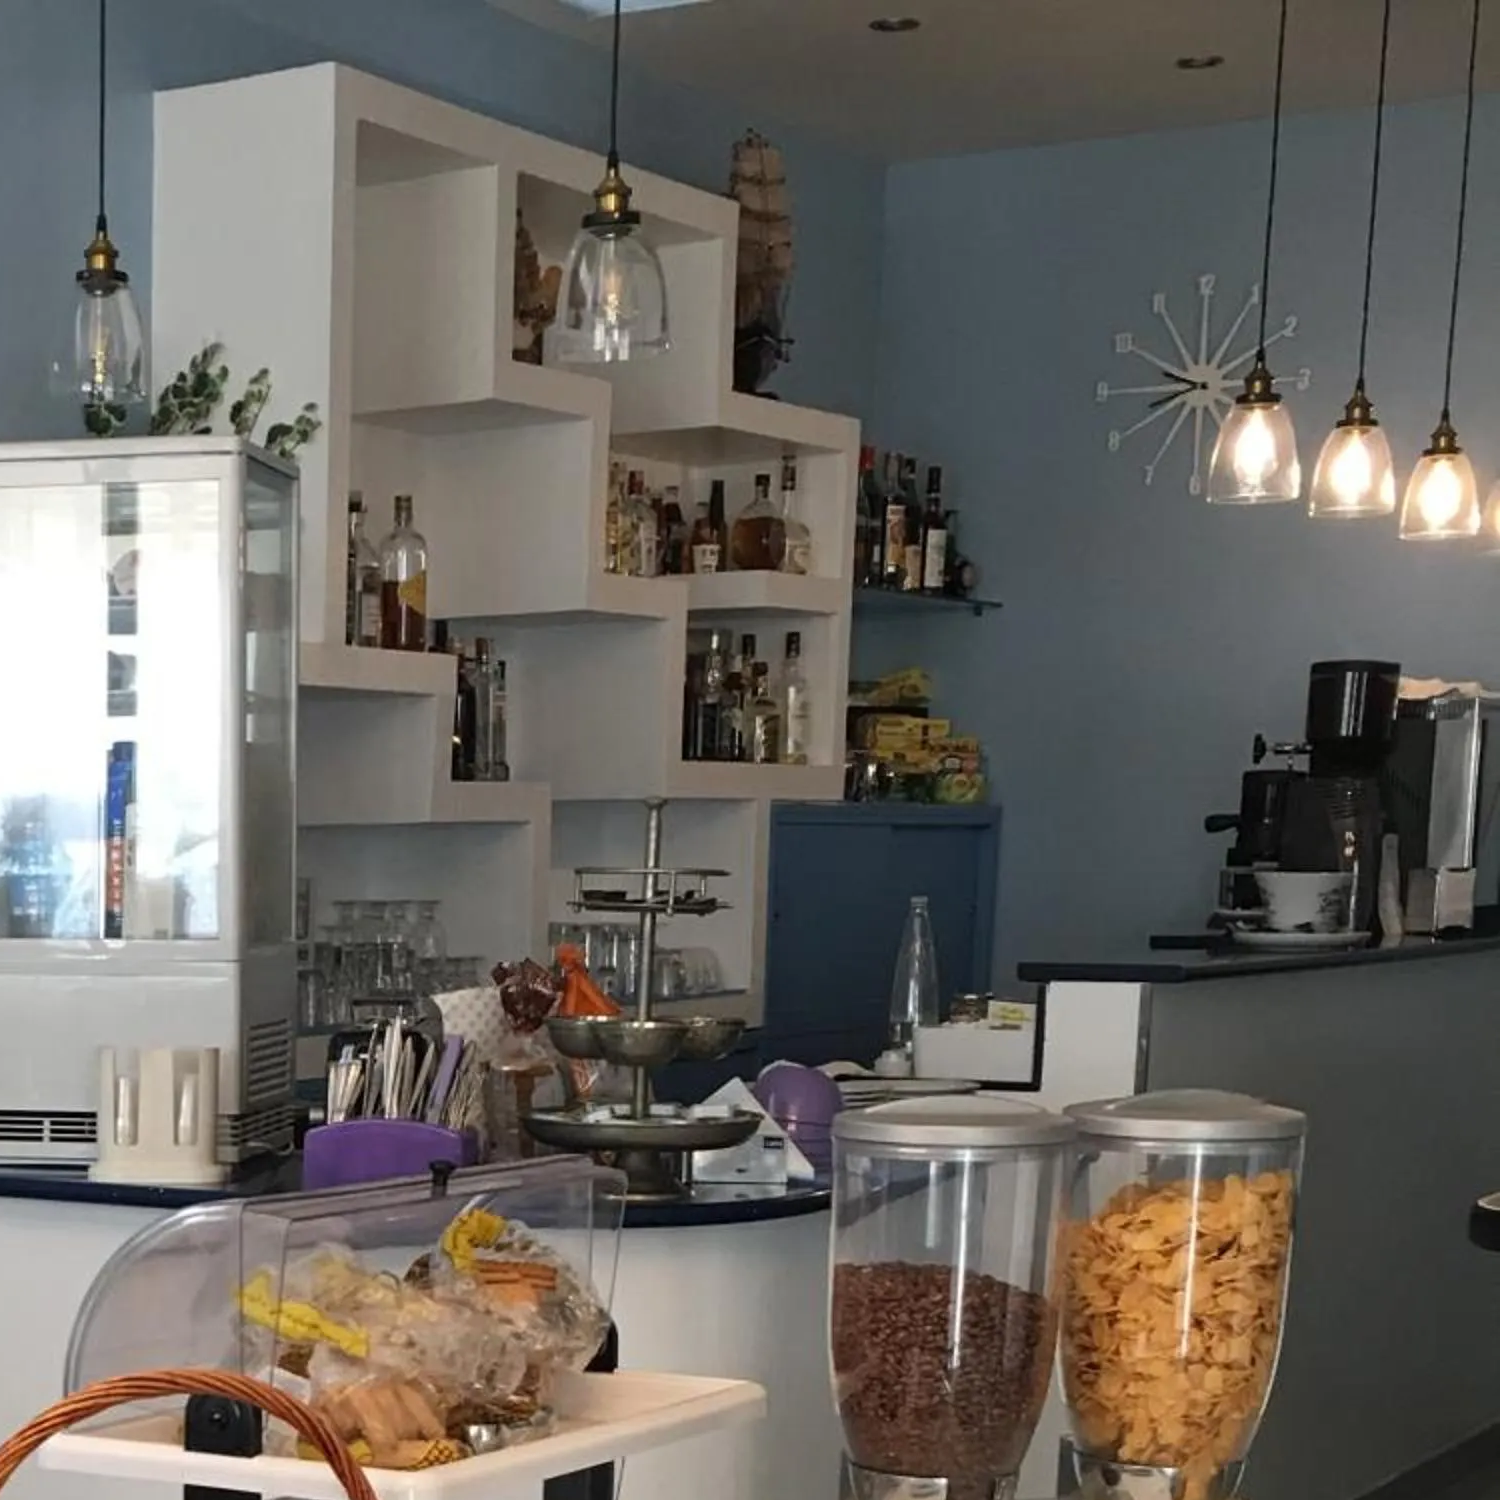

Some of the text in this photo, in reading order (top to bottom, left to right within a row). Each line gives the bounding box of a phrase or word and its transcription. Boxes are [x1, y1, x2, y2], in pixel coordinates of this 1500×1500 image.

[1282, 316, 1298, 337] 2
[1296, 368, 1311, 391] 3
[1095, 381, 1108, 402] 9
[1108, 430, 1119, 452] 8
